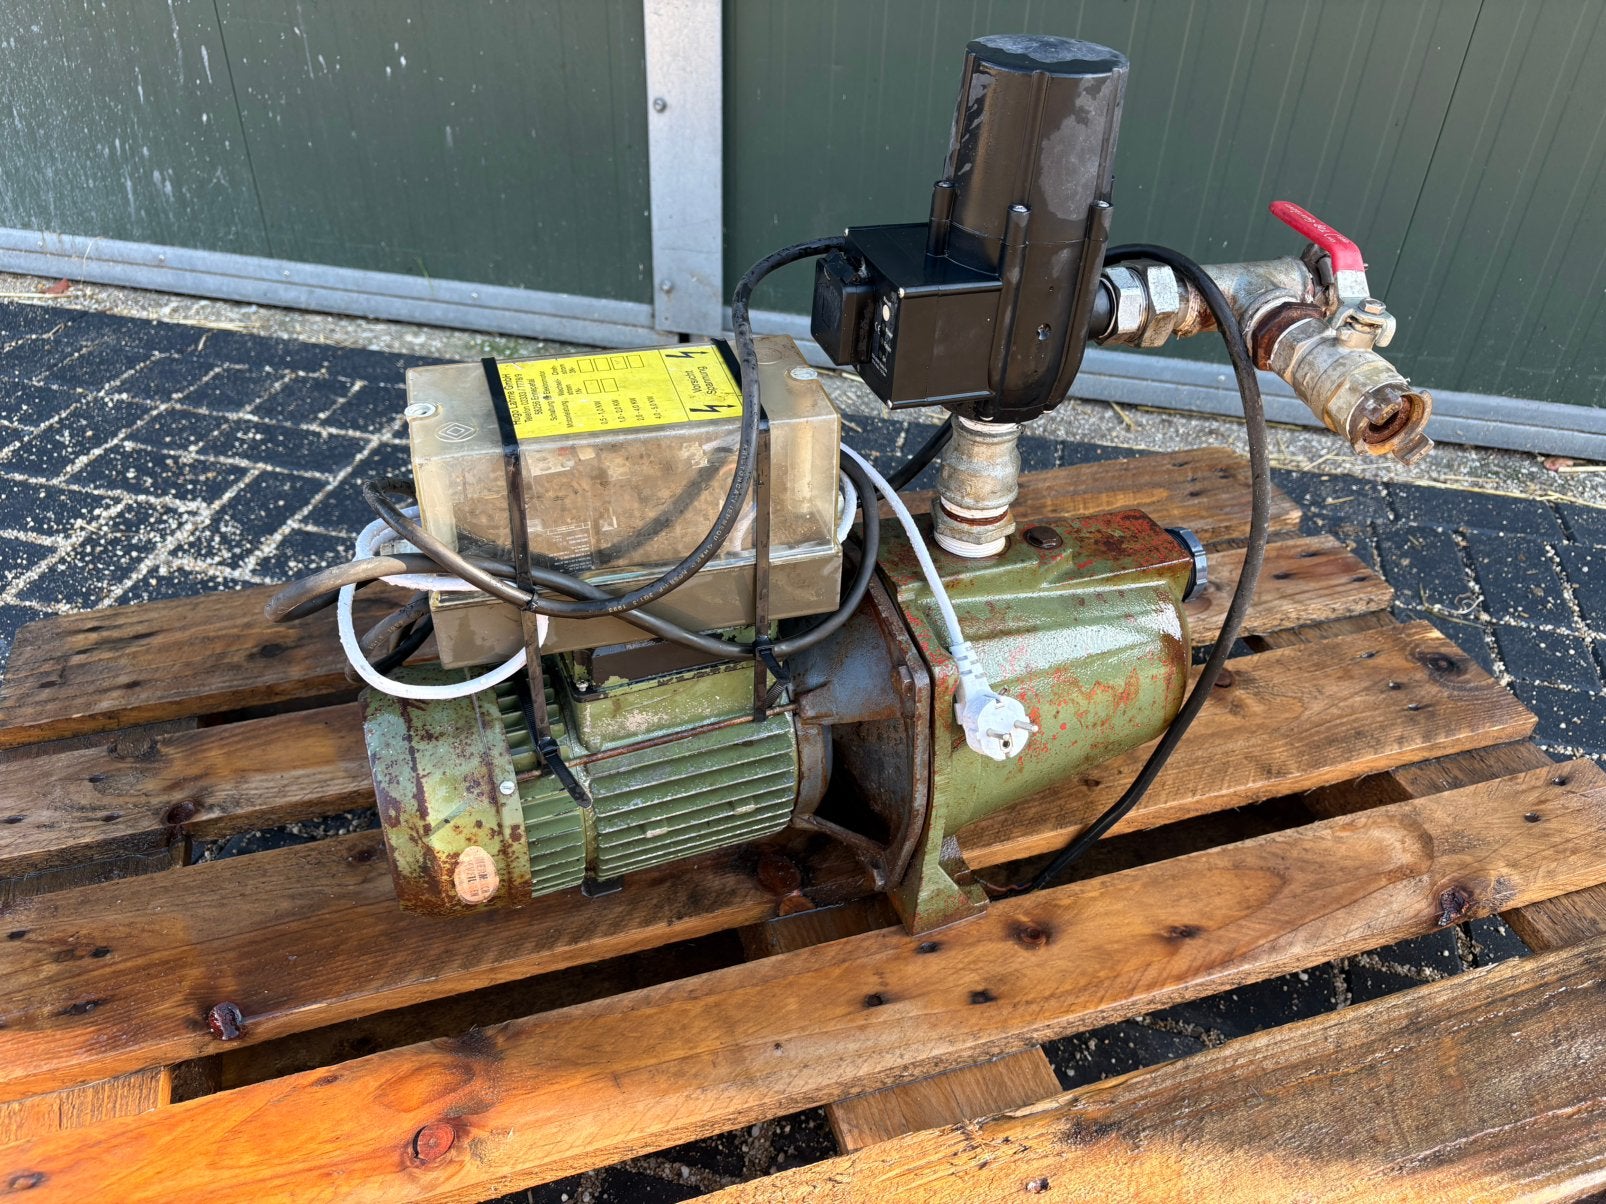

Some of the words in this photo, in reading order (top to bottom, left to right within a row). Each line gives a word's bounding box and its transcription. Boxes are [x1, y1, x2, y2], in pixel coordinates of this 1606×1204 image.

[502, 374, 513, 390] GmbH
[528, 378, 540, 400] Ennepetal
[539, 370, 551, 394] Elektromotor
[685, 370, 702, 393] Vorsicht
[697, 366, 718, 395] Spannung
[512, 409, 523, 424] Hugo
[522, 406, 533, 422] Telefon
[546, 401, 560, 421] Schaltung
[562, 400, 574, 428] Motorleistung
